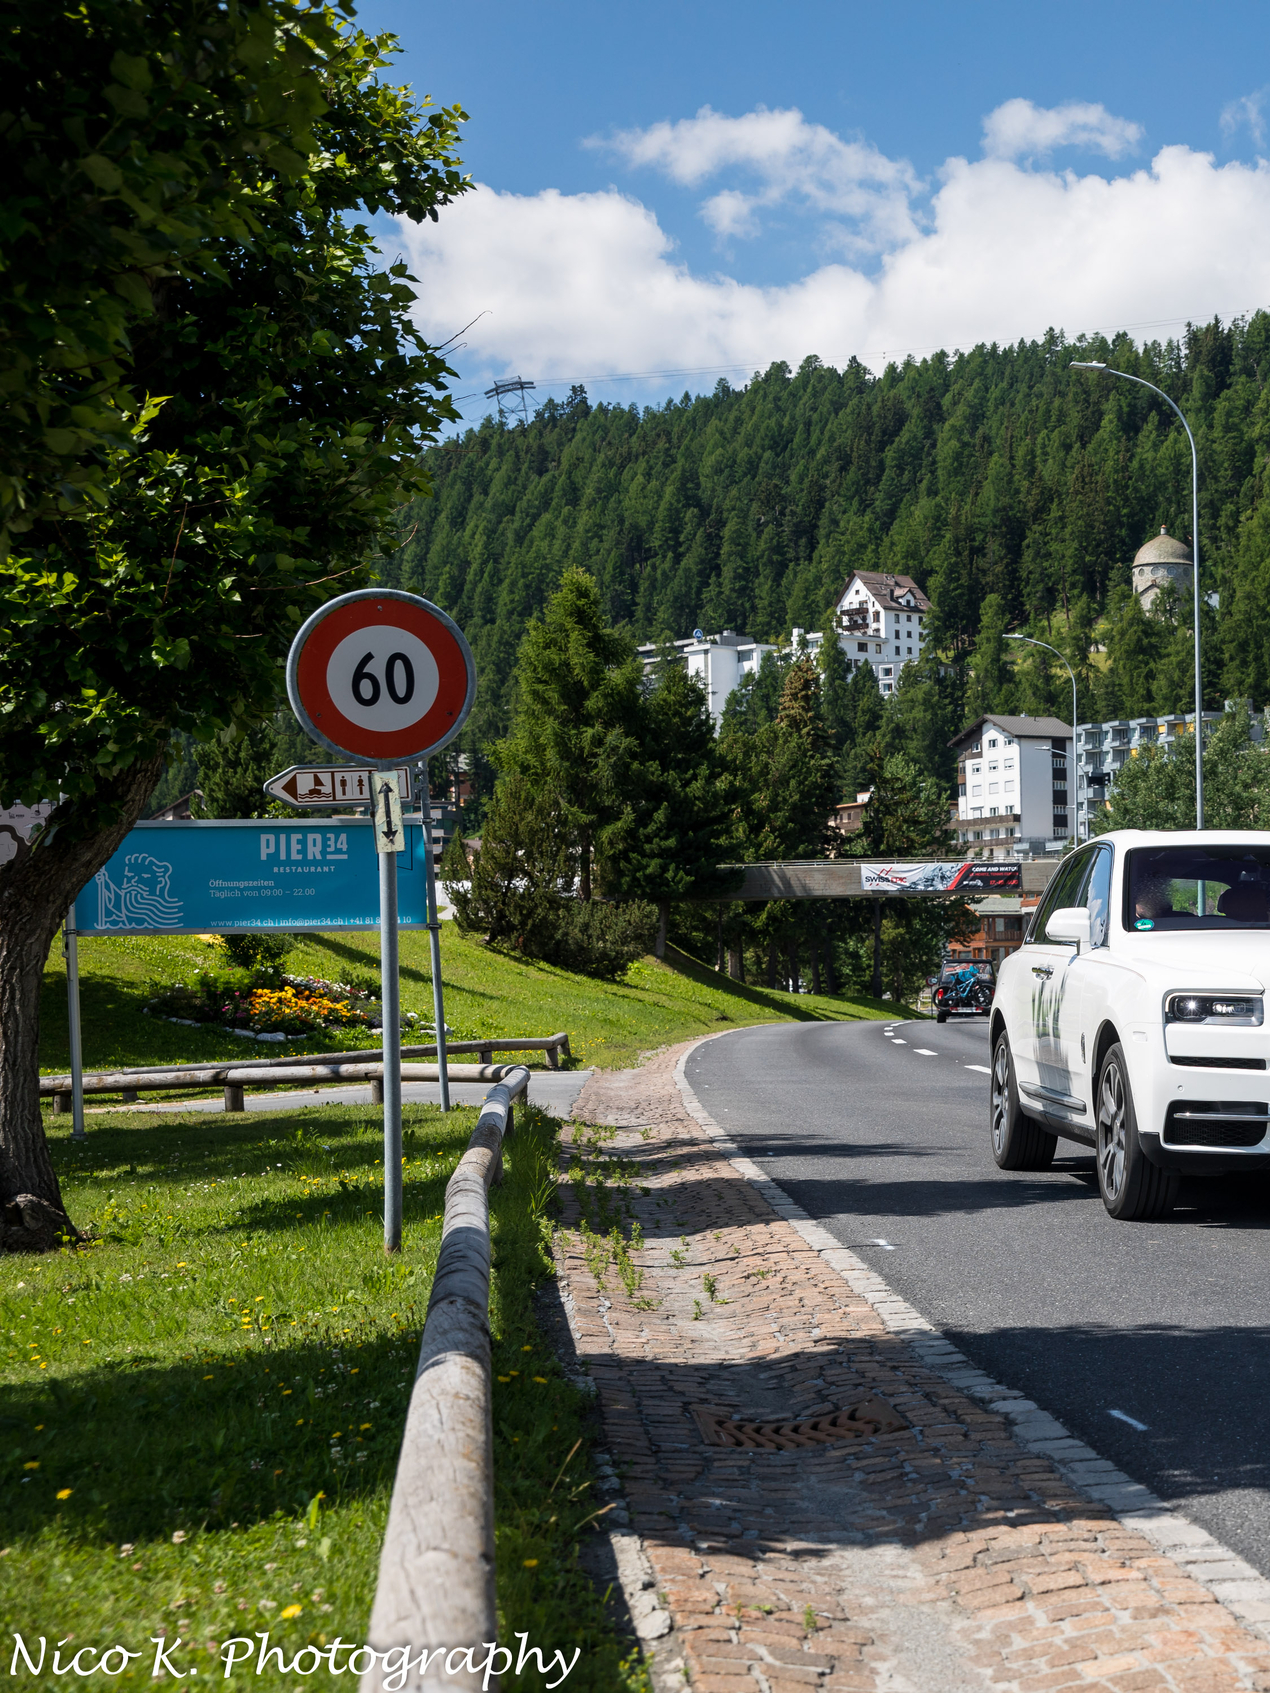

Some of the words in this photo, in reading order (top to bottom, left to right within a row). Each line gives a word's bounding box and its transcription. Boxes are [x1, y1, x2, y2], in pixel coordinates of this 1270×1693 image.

[351, 651, 415, 707] 60
[208, 879, 274, 888] Öffnungszeiten
[209, 890, 241, 899] Täglich
[260, 888, 284, 896] 09:00
[292, 888, 316, 896] 22.00
[210, 918, 274, 927] www.pier34.ch
[280, 917, 344, 926] info@pier34.ch
